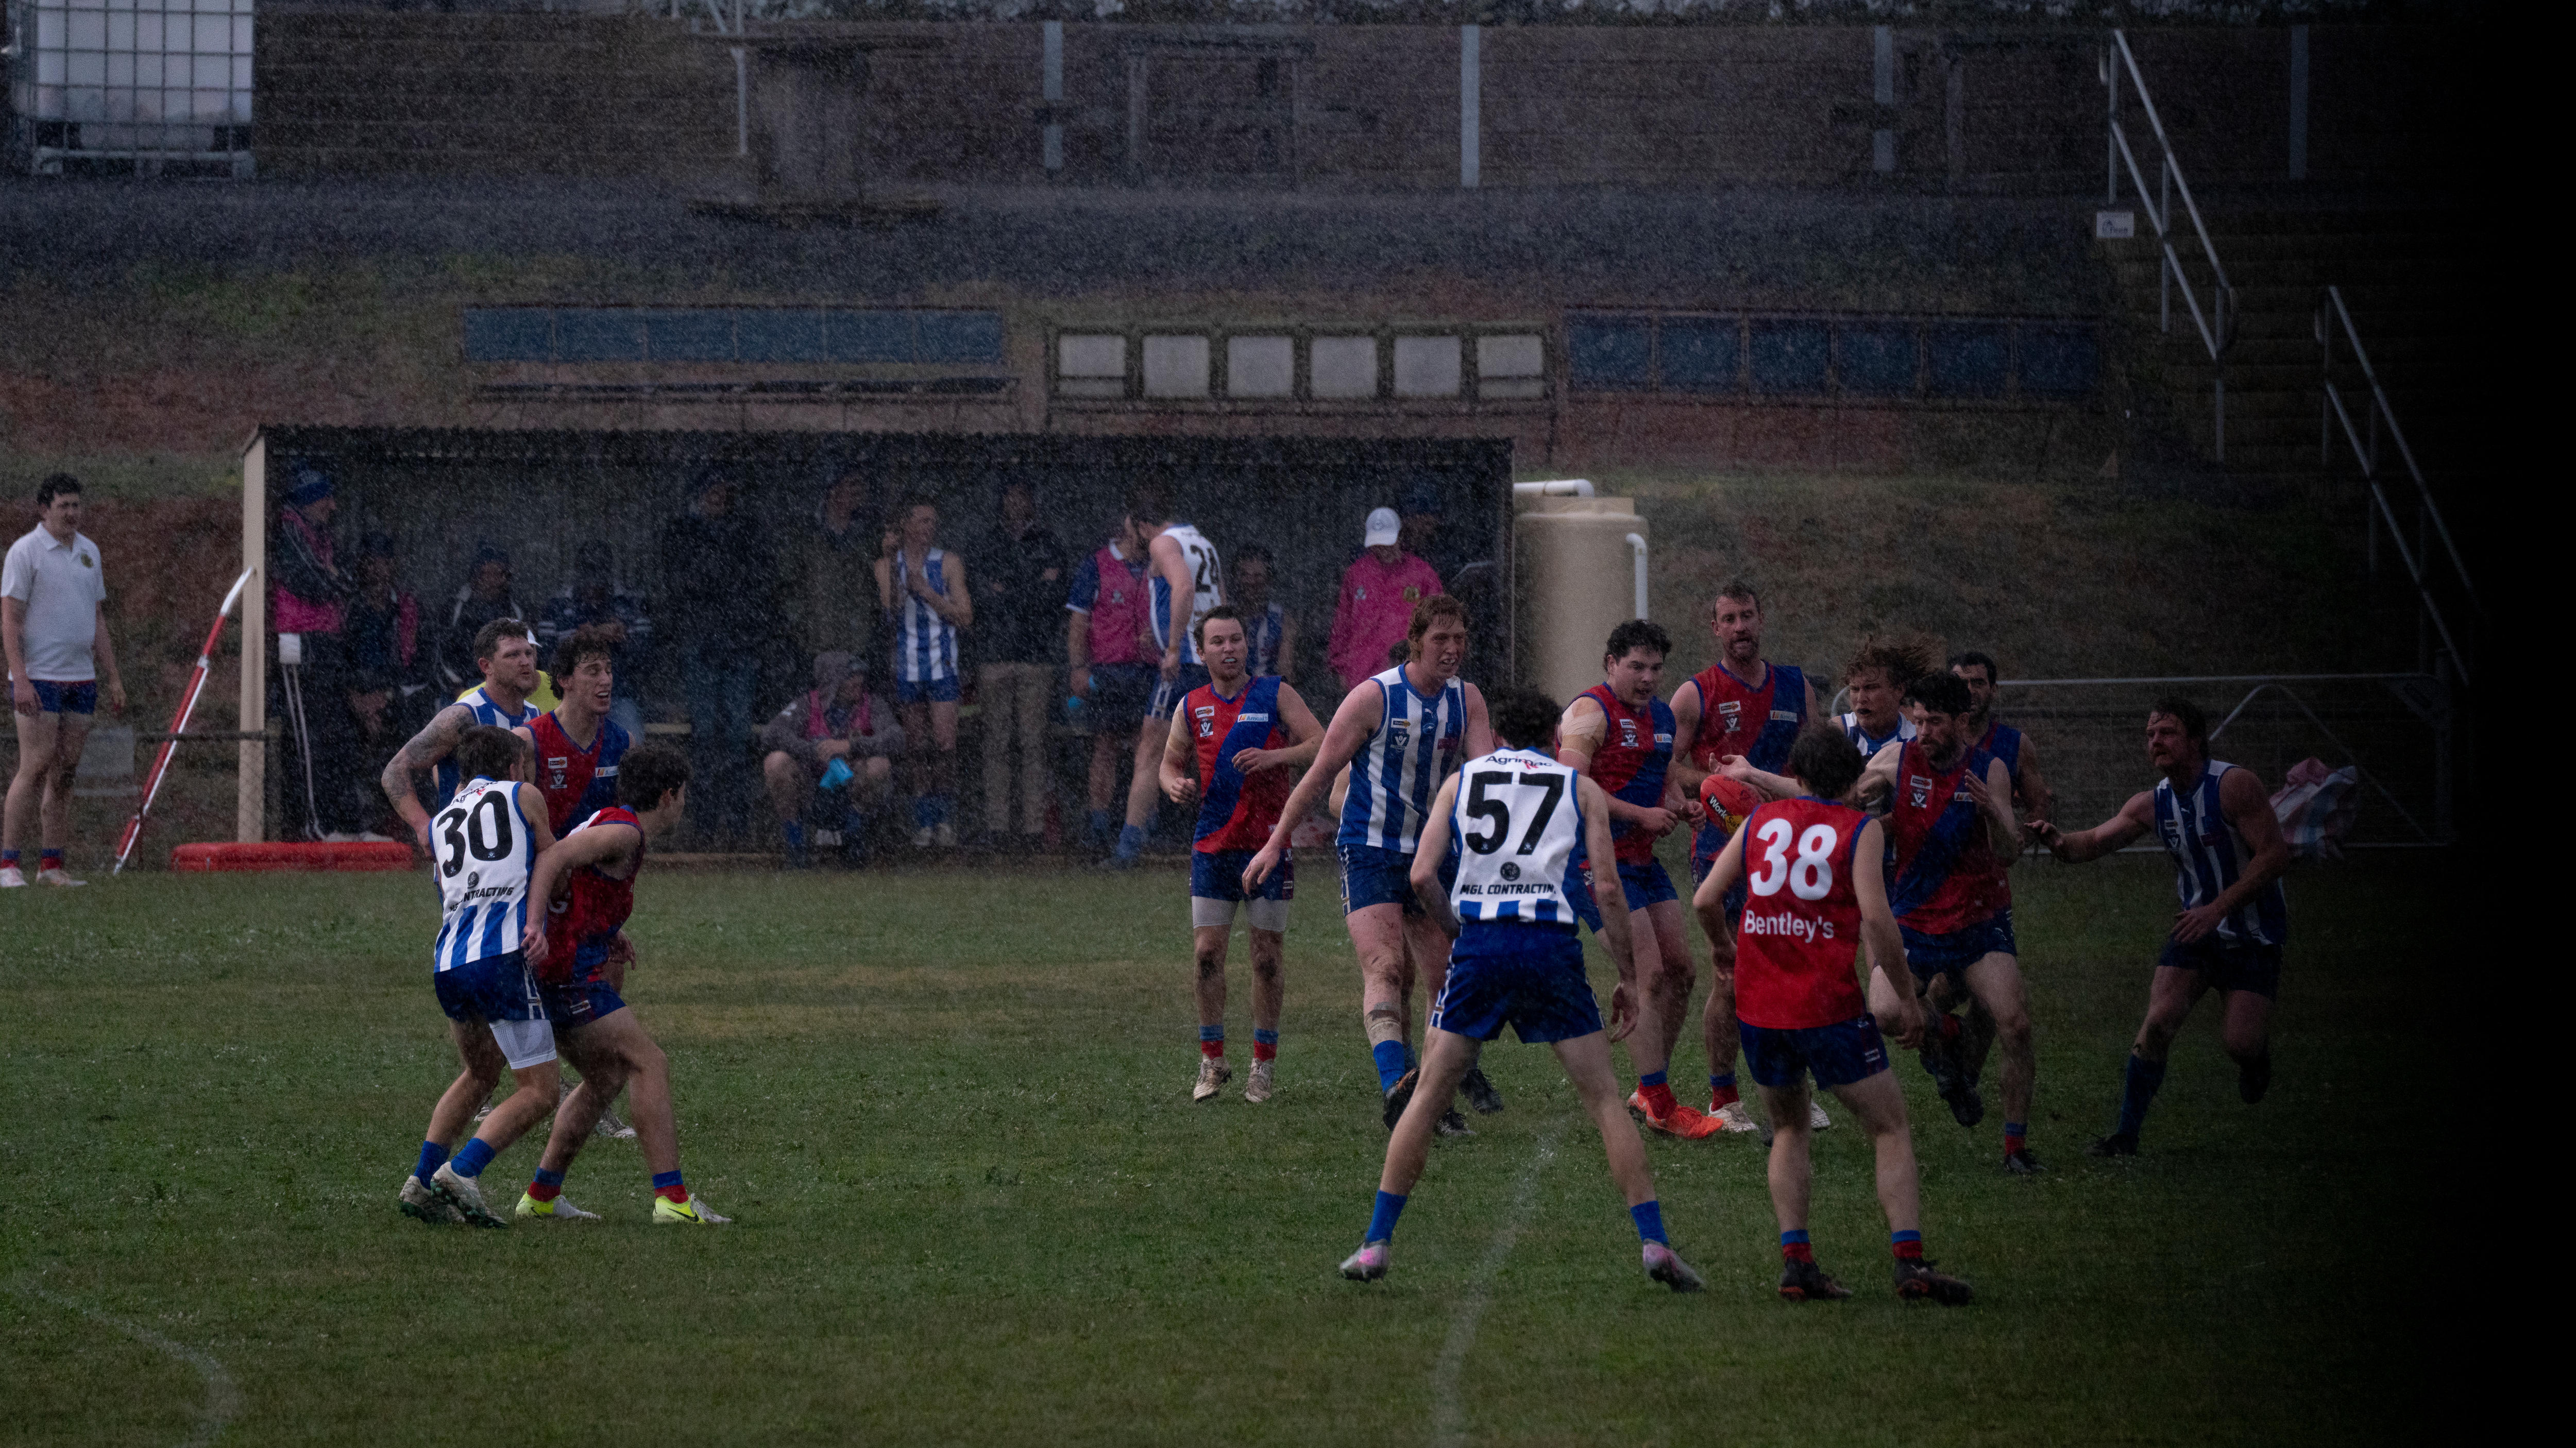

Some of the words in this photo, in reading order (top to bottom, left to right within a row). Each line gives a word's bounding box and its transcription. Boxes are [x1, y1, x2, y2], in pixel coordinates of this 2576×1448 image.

[436, 790, 513, 878] 30
[1465, 771, 1566, 856] 57
[1750, 817, 1838, 901] 38
[462, 887, 515, 901] NTRACTING
[1460, 884, 1484, 895] MGL
[1487, 883, 1556, 895] CONTRACTIN
[1744, 909, 1835, 943] Bentley's
